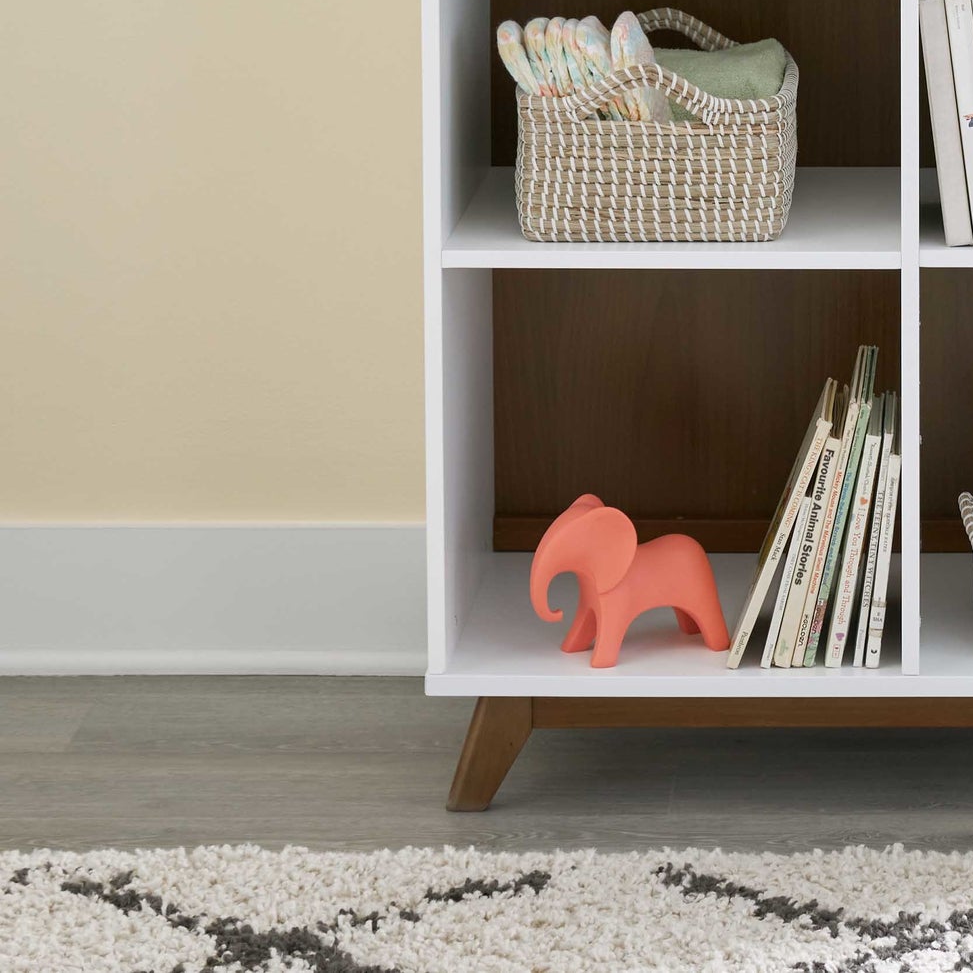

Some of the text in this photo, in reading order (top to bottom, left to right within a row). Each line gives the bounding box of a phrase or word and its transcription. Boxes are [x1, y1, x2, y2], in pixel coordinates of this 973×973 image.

[813, 437, 823, 450] THE
[797, 475, 808, 491] CAT
[813, 448, 834, 501] Favourite
[832, 471, 842, 489] Mickey
[829, 489, 838, 507] Mouse
[876, 490, 884, 508] THE
[804, 501, 822, 542] Animal
[854, 513, 864, 530] Love
[769, 531, 785, 561] Stan Mack
[851, 531, 861, 546] You
[794, 543, 812, 586] Stories
[844, 547, 858, 578] Through
[843, 580, 852, 594] and
[861, 566, 873, 608] WITCHES
[836, 594, 850, 625] Through
